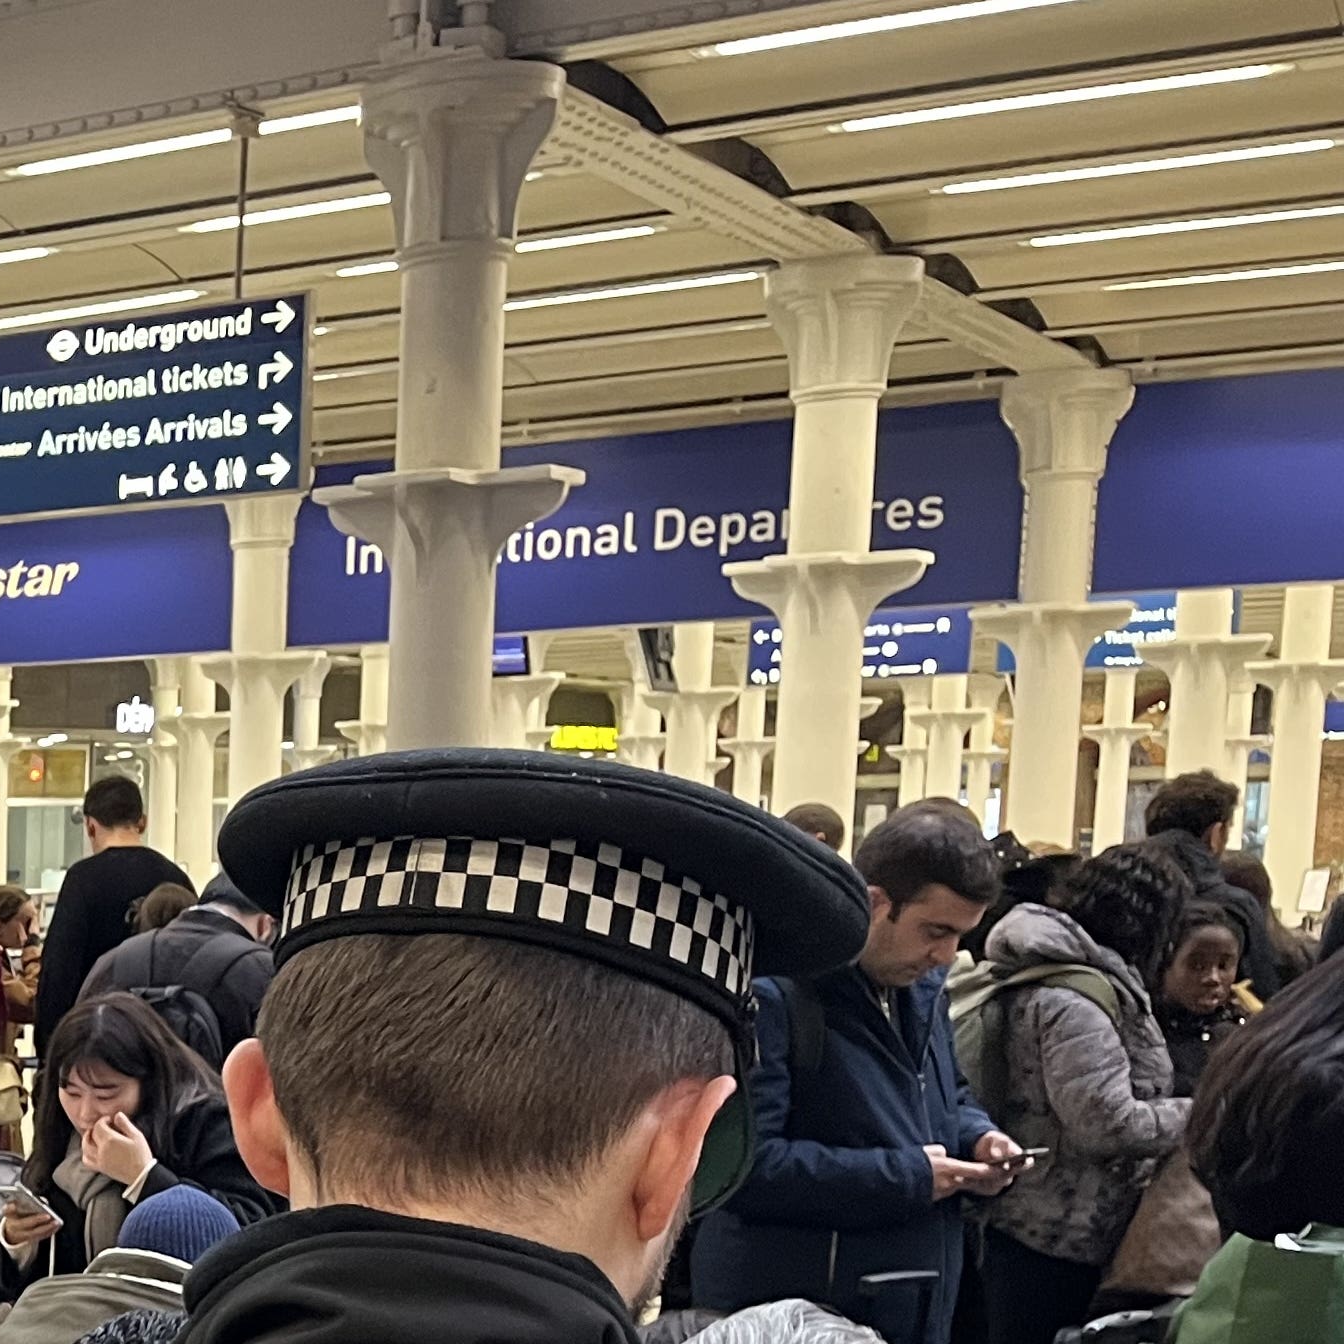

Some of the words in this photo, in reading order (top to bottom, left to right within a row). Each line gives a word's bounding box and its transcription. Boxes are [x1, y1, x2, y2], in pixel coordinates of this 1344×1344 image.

[85, 307, 252, 357] Underground
[1, 372, 157, 413] International
[161, 360, 248, 393] tickets
[36, 421, 141, 457] Arrivées
[145, 409, 248, 446] Arrivals
[345, 510, 639, 575] Intional
[654, 494, 944, 556] Depares
